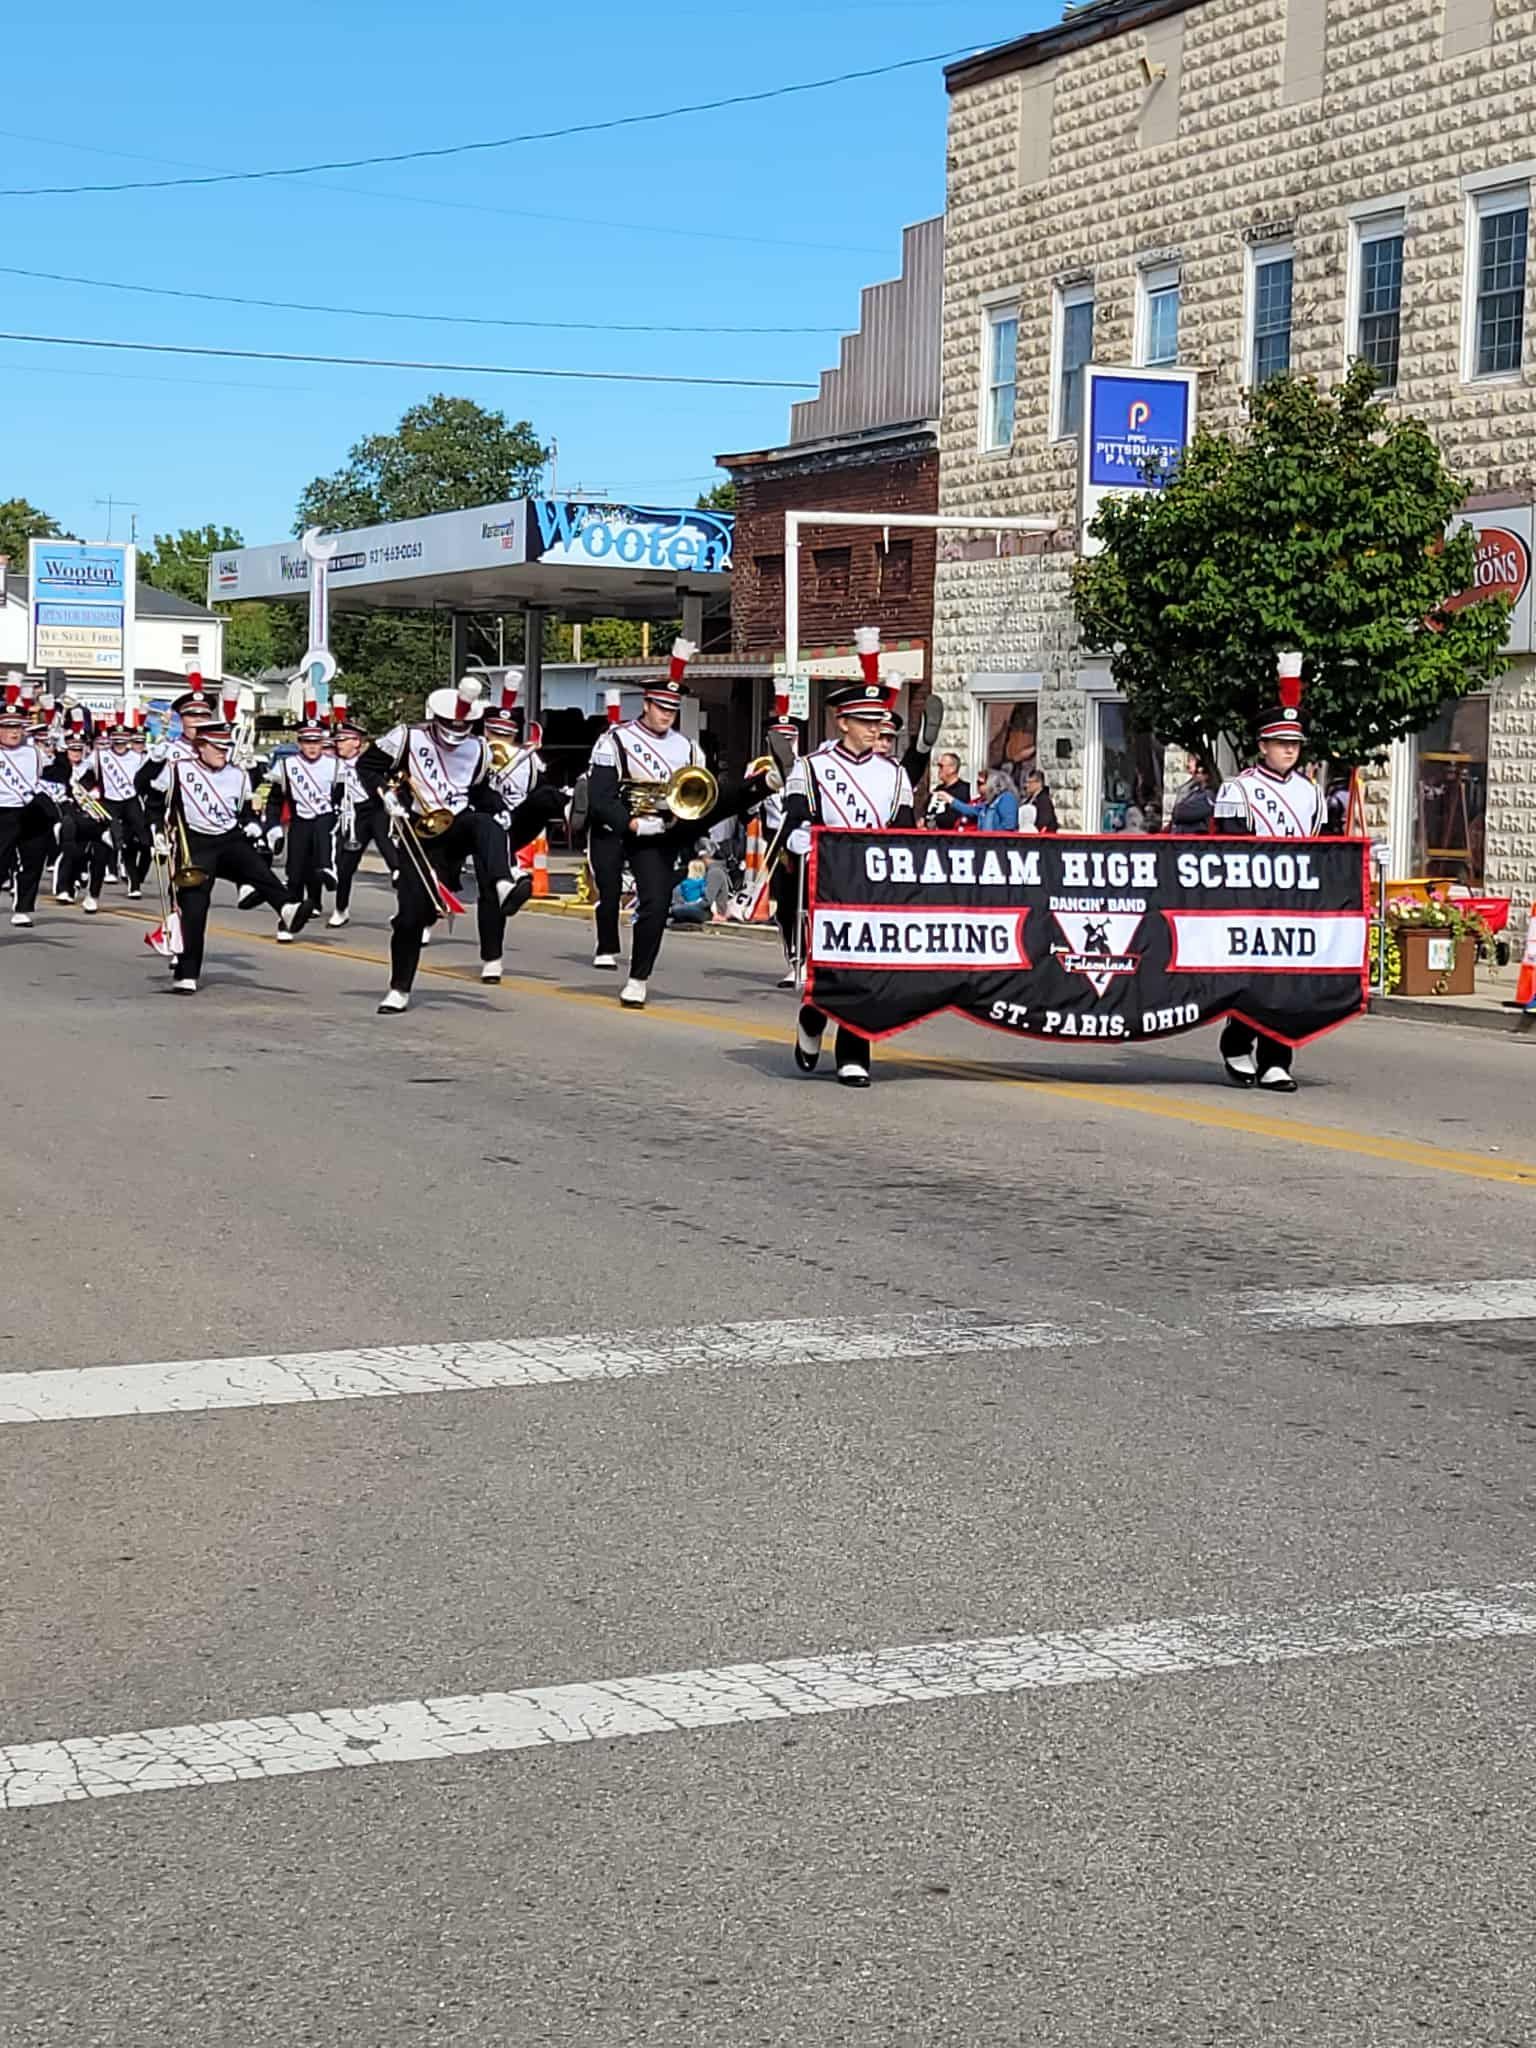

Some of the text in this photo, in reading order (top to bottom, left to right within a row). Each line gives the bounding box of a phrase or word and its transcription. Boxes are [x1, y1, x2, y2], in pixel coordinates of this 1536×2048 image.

[1105, 453, 1169, 467] PANS
[533, 500, 724, 573] Wooten
[45, 560, 115, 580] Wooten
[1473, 551, 1518, 587] IONS
[865, 847, 1320, 890] GRAHAM HIGH SCHOOL
[1049, 896, 1147, 912] DANCIN' BAND
[822, 921, 1009, 954] MARCHING
[1227, 927, 1317, 957] BAND
[989, 1001, 1200, 1037] ST. PARIS, OHIO
